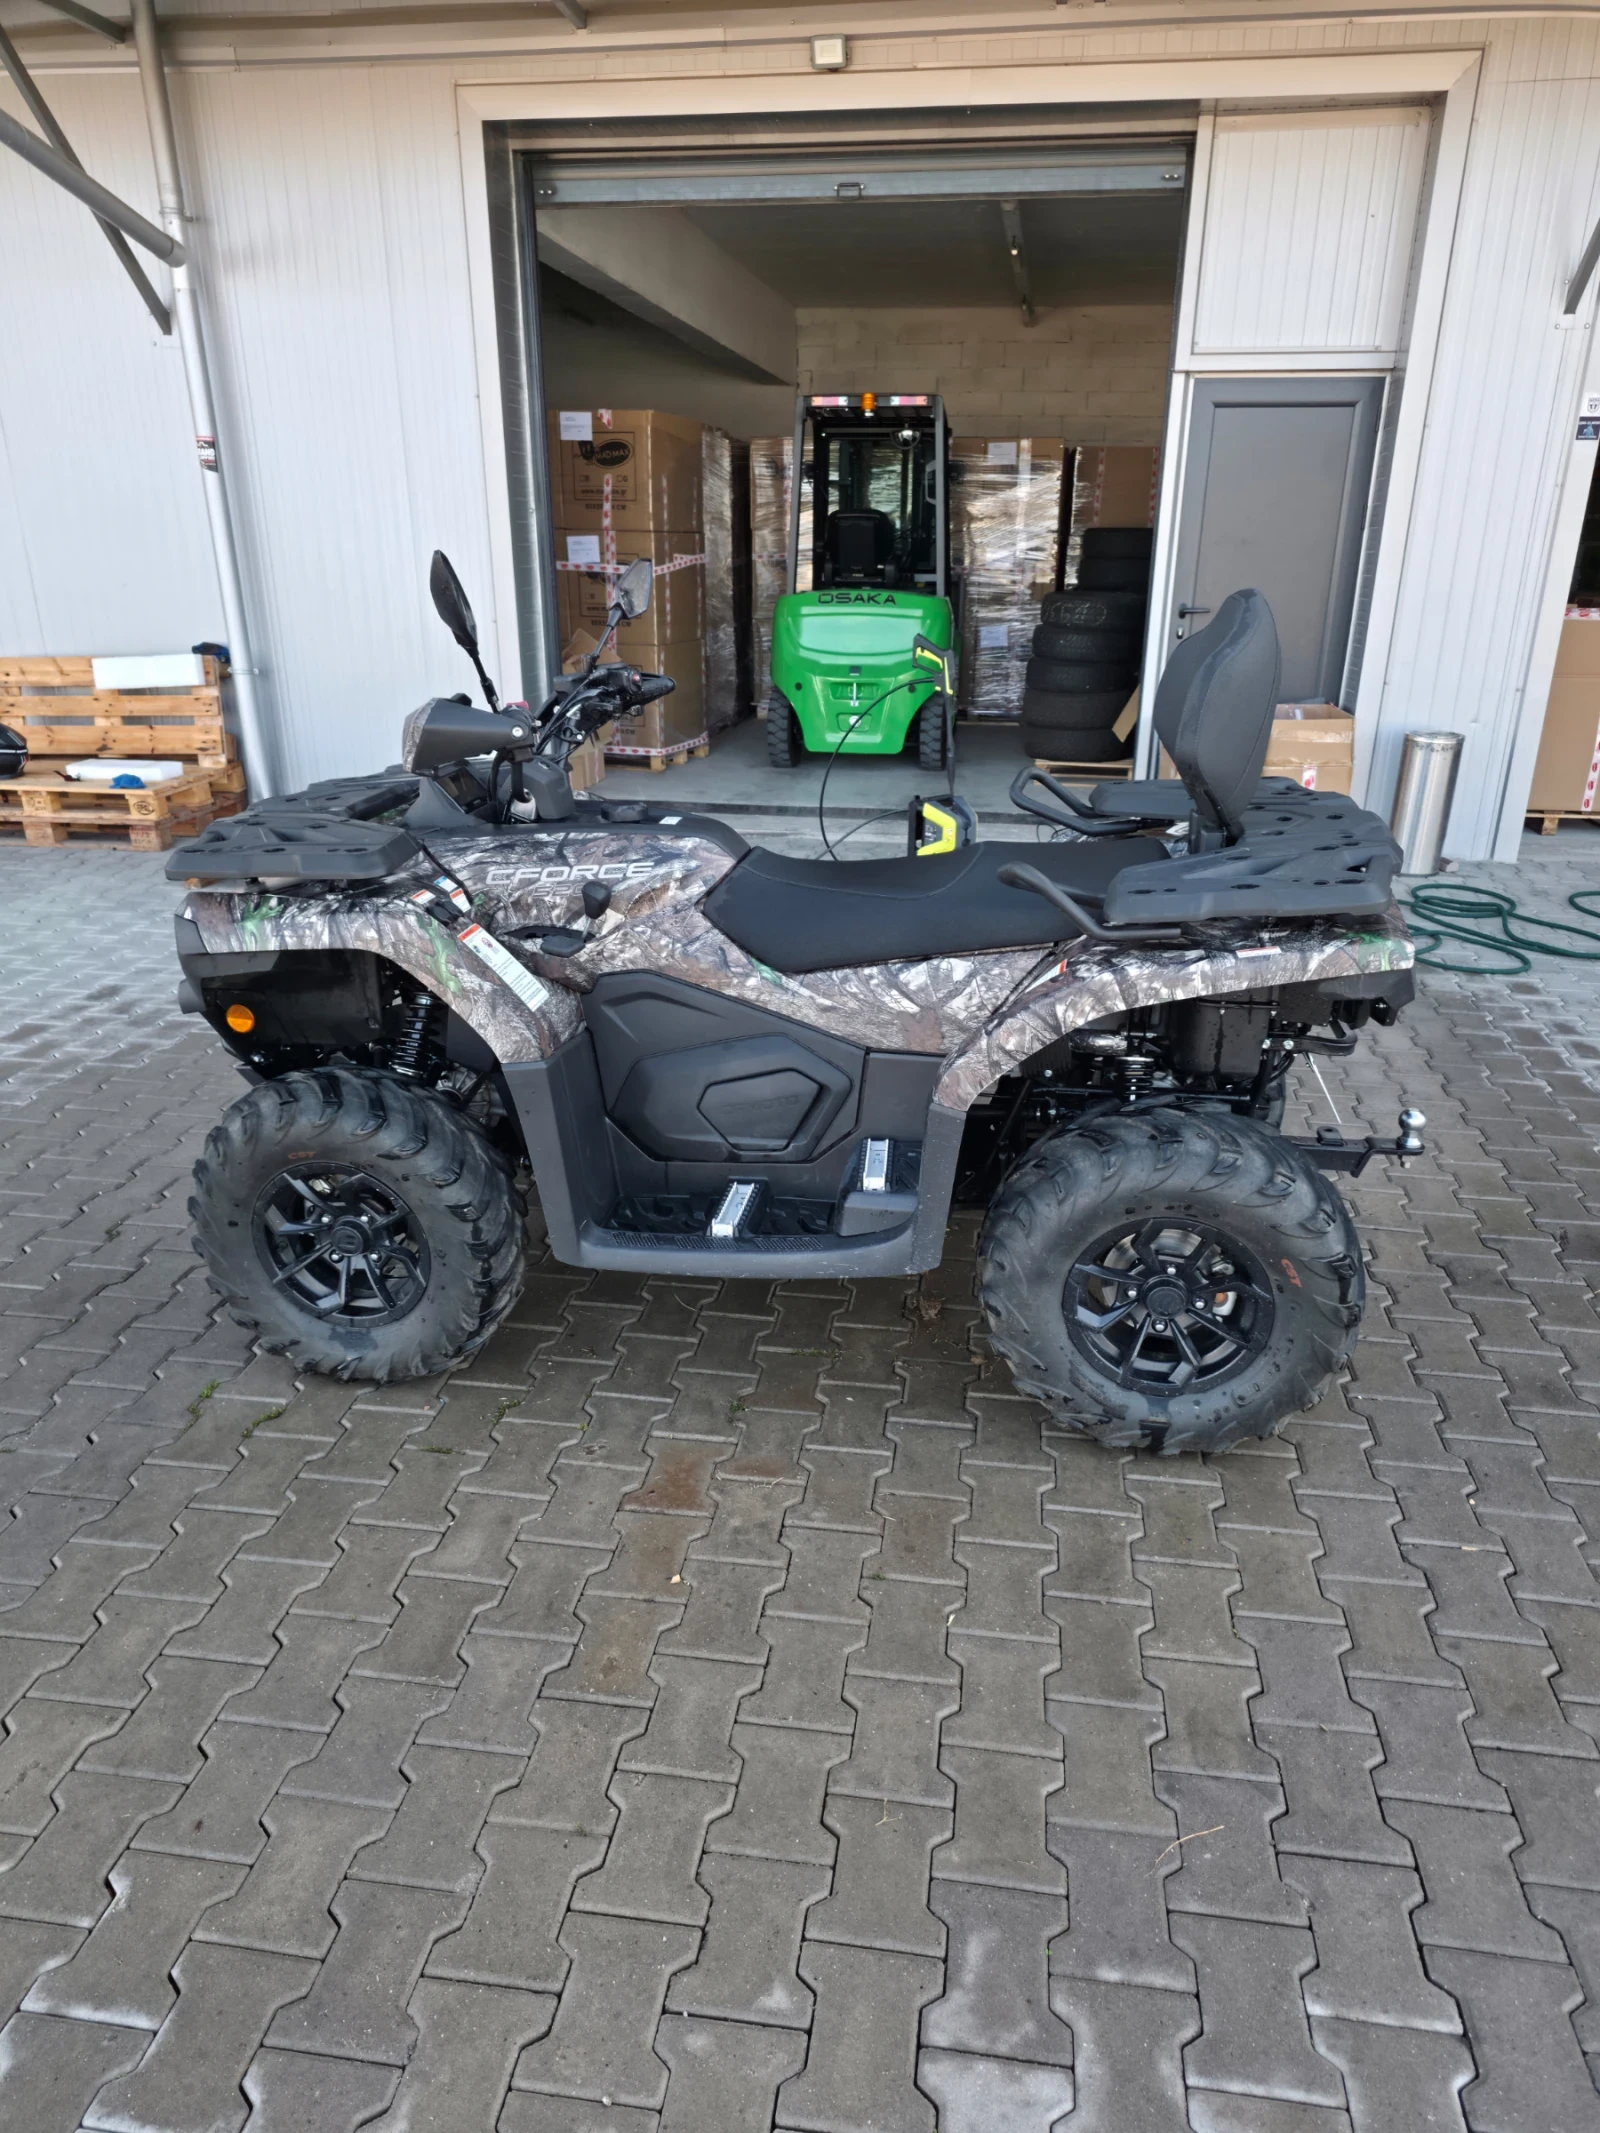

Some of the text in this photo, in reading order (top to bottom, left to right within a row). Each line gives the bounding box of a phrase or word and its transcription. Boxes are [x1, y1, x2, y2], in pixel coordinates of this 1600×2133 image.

[818, 592, 897, 606] OSAKA
[485, 862, 655, 885] CFORCE
[1281, 1258, 1303, 1288] CST
